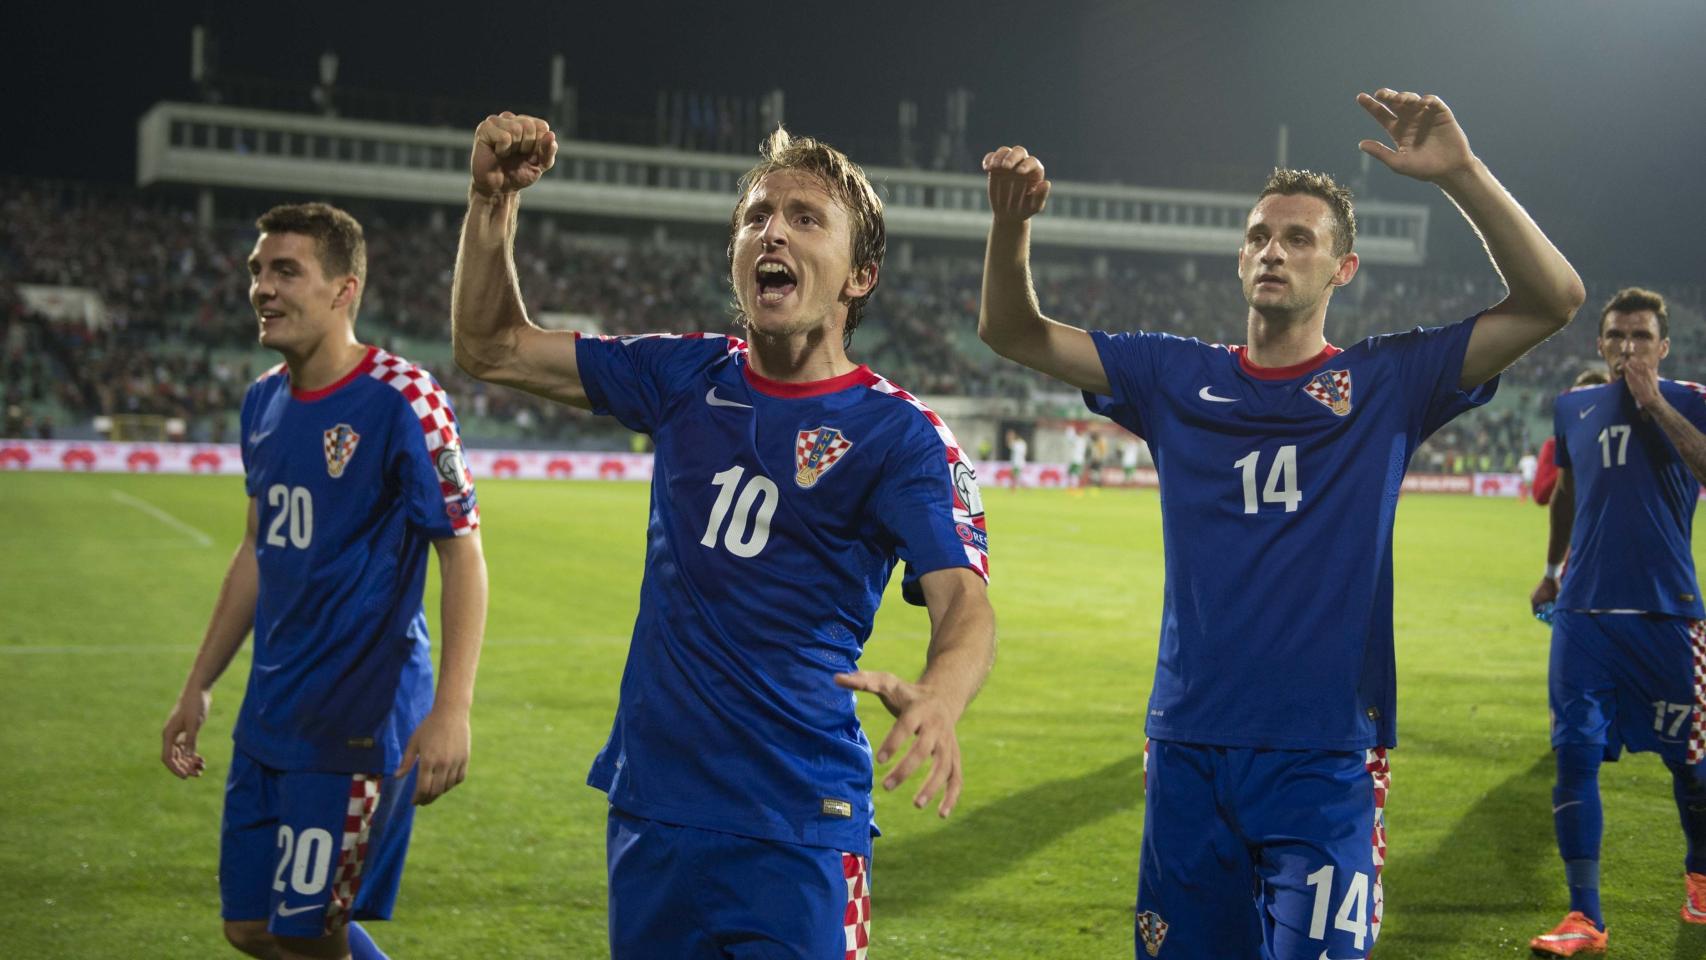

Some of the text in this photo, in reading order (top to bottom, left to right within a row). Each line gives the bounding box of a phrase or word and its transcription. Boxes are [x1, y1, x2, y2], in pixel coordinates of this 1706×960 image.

[1233, 445, 1303, 514] 14
[1598, 425, 1631, 468] 17
[266, 484, 313, 550] 20
[700, 465, 779, 558] 10
[1652, 700, 1692, 737] 17
[272, 824, 334, 895] 20
[1306, 864, 1369, 951] 14
